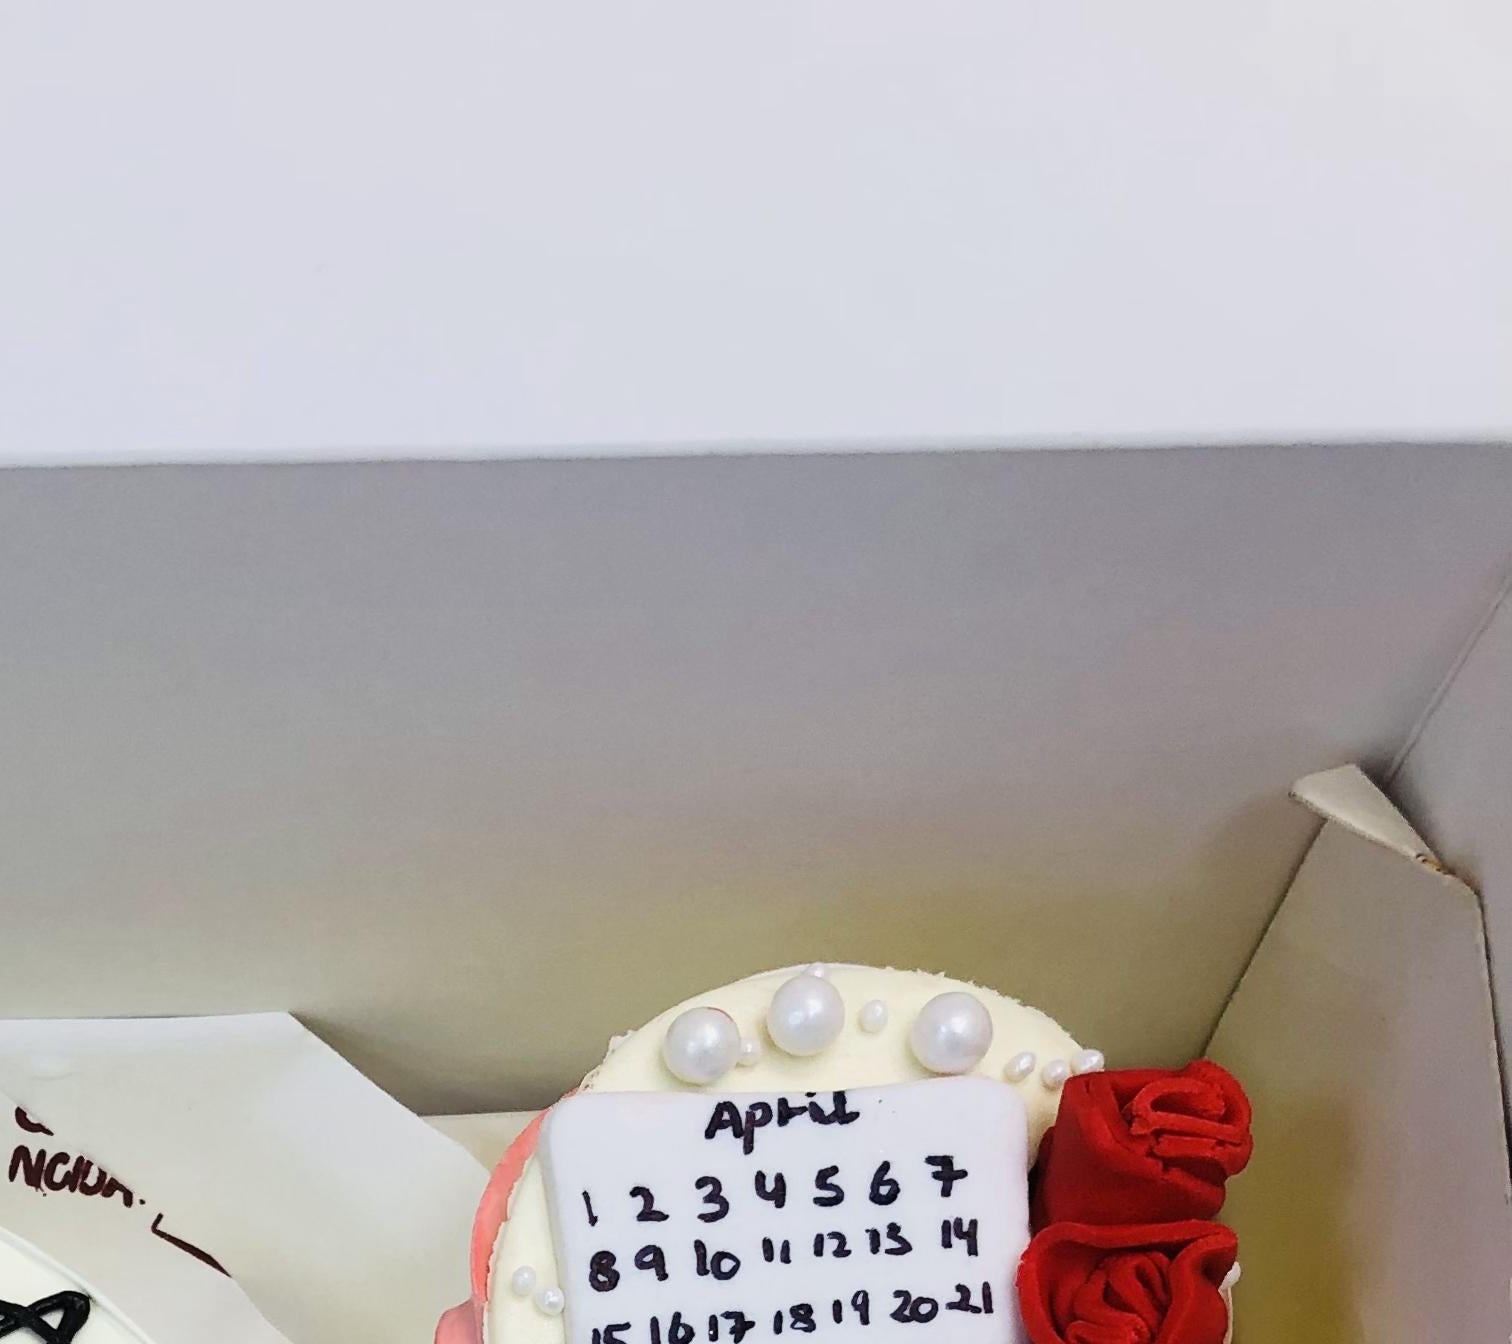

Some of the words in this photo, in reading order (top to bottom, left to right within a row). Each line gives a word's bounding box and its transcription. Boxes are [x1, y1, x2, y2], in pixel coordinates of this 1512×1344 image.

[705, 1091, 860, 1155] April
[583, 1191, 597, 1226] 1
[630, 1186, 669, 1222] 2
[695, 1176, 729, 1223] 3
[755, 1171, 786, 1208] 4
[813, 1166, 844, 1207] 5
[869, 1161, 900, 1205] 6
[925, 1155, 968, 1197] 7
[589, 1251, 620, 1292] 8
[635, 1245, 668, 1281] 9
[694, 1240, 740, 1280] 10
[763, 1237, 791, 1264] 11
[814, 1232, 851, 1257] 12
[865, 1223, 912, 1255] 13
[942, 1218, 978, 1256] 14
[709, 1311, 755, 1344] 17
[774, 1304, 816, 1334] 18
[833, 1290, 869, 1325] 19
[890, 1290, 938, 1323] 20
[946, 1282, 993, 1314] 21
